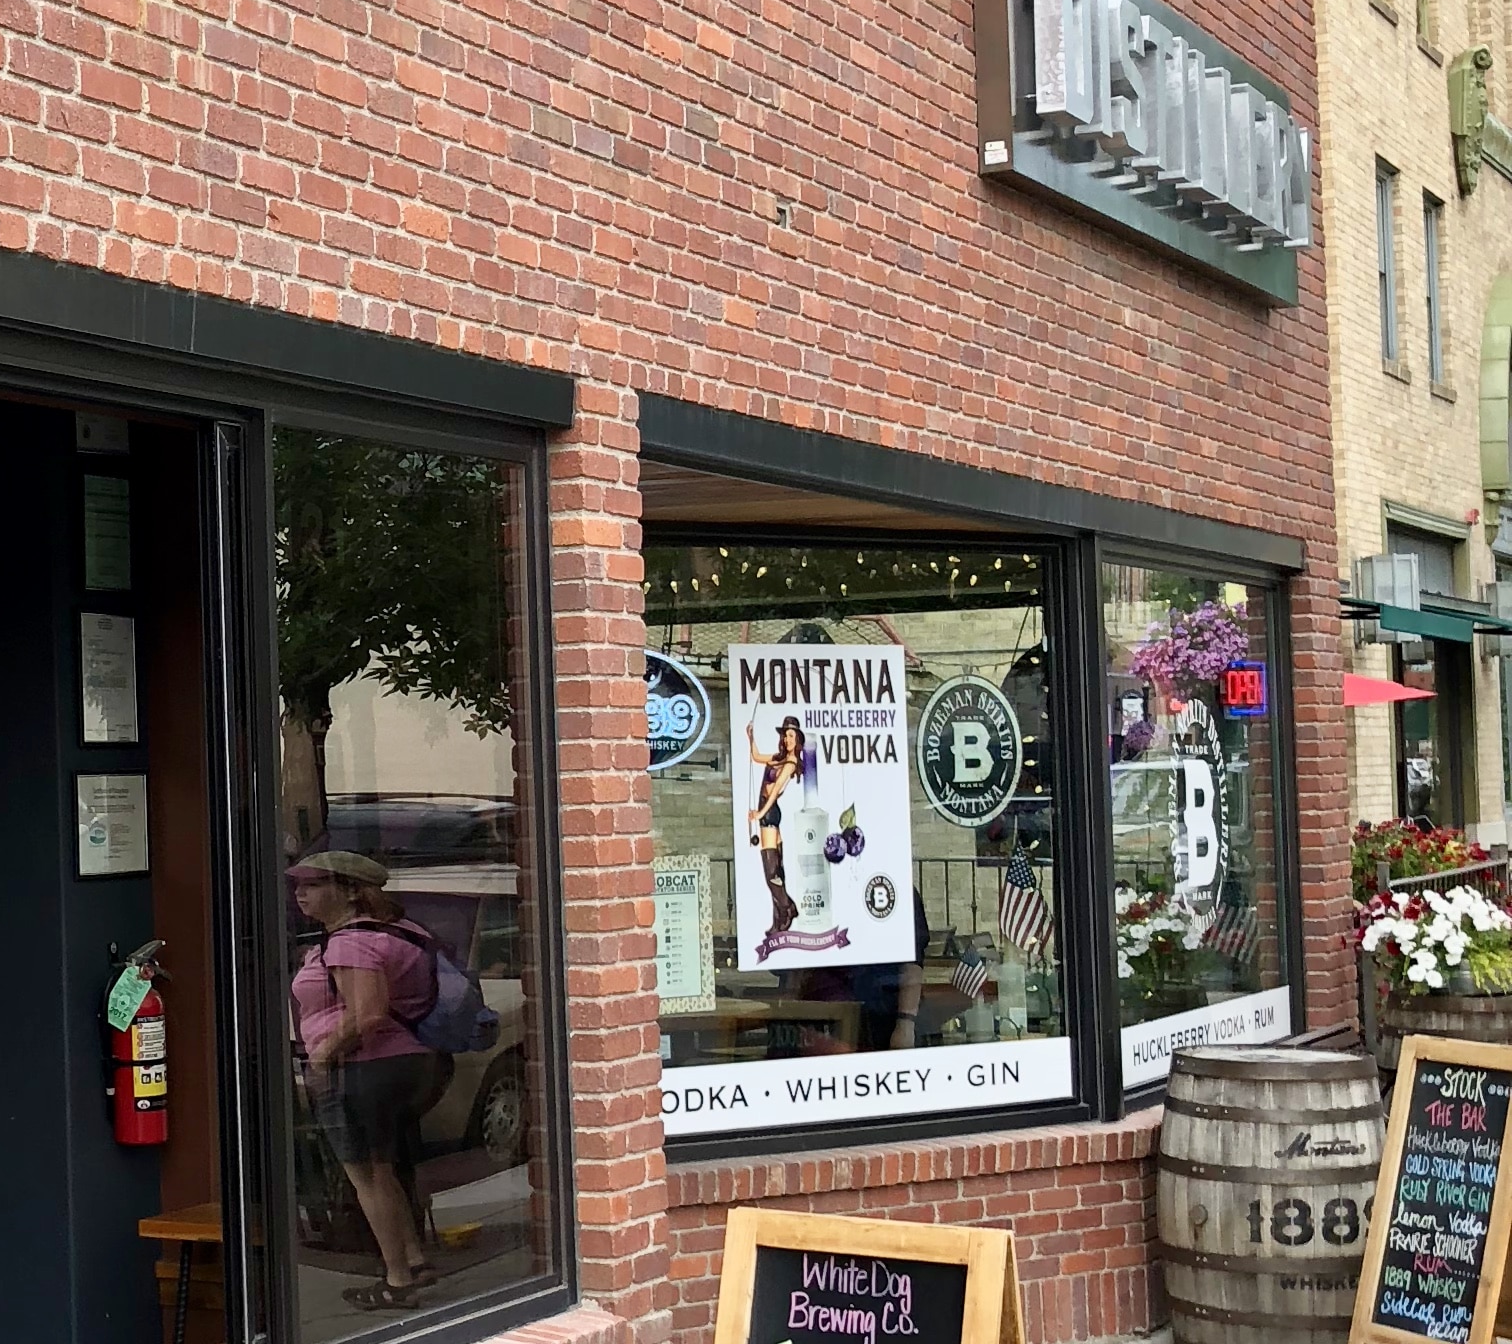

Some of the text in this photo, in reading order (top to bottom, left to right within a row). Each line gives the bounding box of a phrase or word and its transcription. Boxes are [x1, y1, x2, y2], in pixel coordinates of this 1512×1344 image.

[740, 658, 896, 704] MONTANA
[805, 709, 896, 728] HUCKLEBERRY
[926, 689, 1014, 763] BOZEMAN SPIRITS
[648, 740, 684, 751] HISKEY
[821, 734, 898, 764] VODKA
[950, 722, 995, 783] B
[1184, 744, 1209, 756] TRADE
[940, 782, 1004, 814] MONTANA
[1182, 758, 1220, 888] B
[656, 874, 696, 887] OBCAT
[1192, 890, 1213, 902] MARK
[1133, 1006, 1275, 1067] HUCKLEBERRY VODKA RUM
[662, 1061, 1021, 1115] ODKA WHISKEY GIN
[1440, 1067, 1487, 1107] STOCK
[1425, 1100, 1487, 1132] THE BAR
[1405, 1154, 1497, 1187] COLD SPRING VODKA
[1449, 1210, 1487, 1237] Vodka
[1384, 1265, 1412, 1292] 1889
[1414, 1253, 1453, 1275] RUM
[803, 1254, 912, 1315] White Dog
[1280, 1274, 1359, 1292] WHISKE
[882, 1302, 919, 1335] Co.
